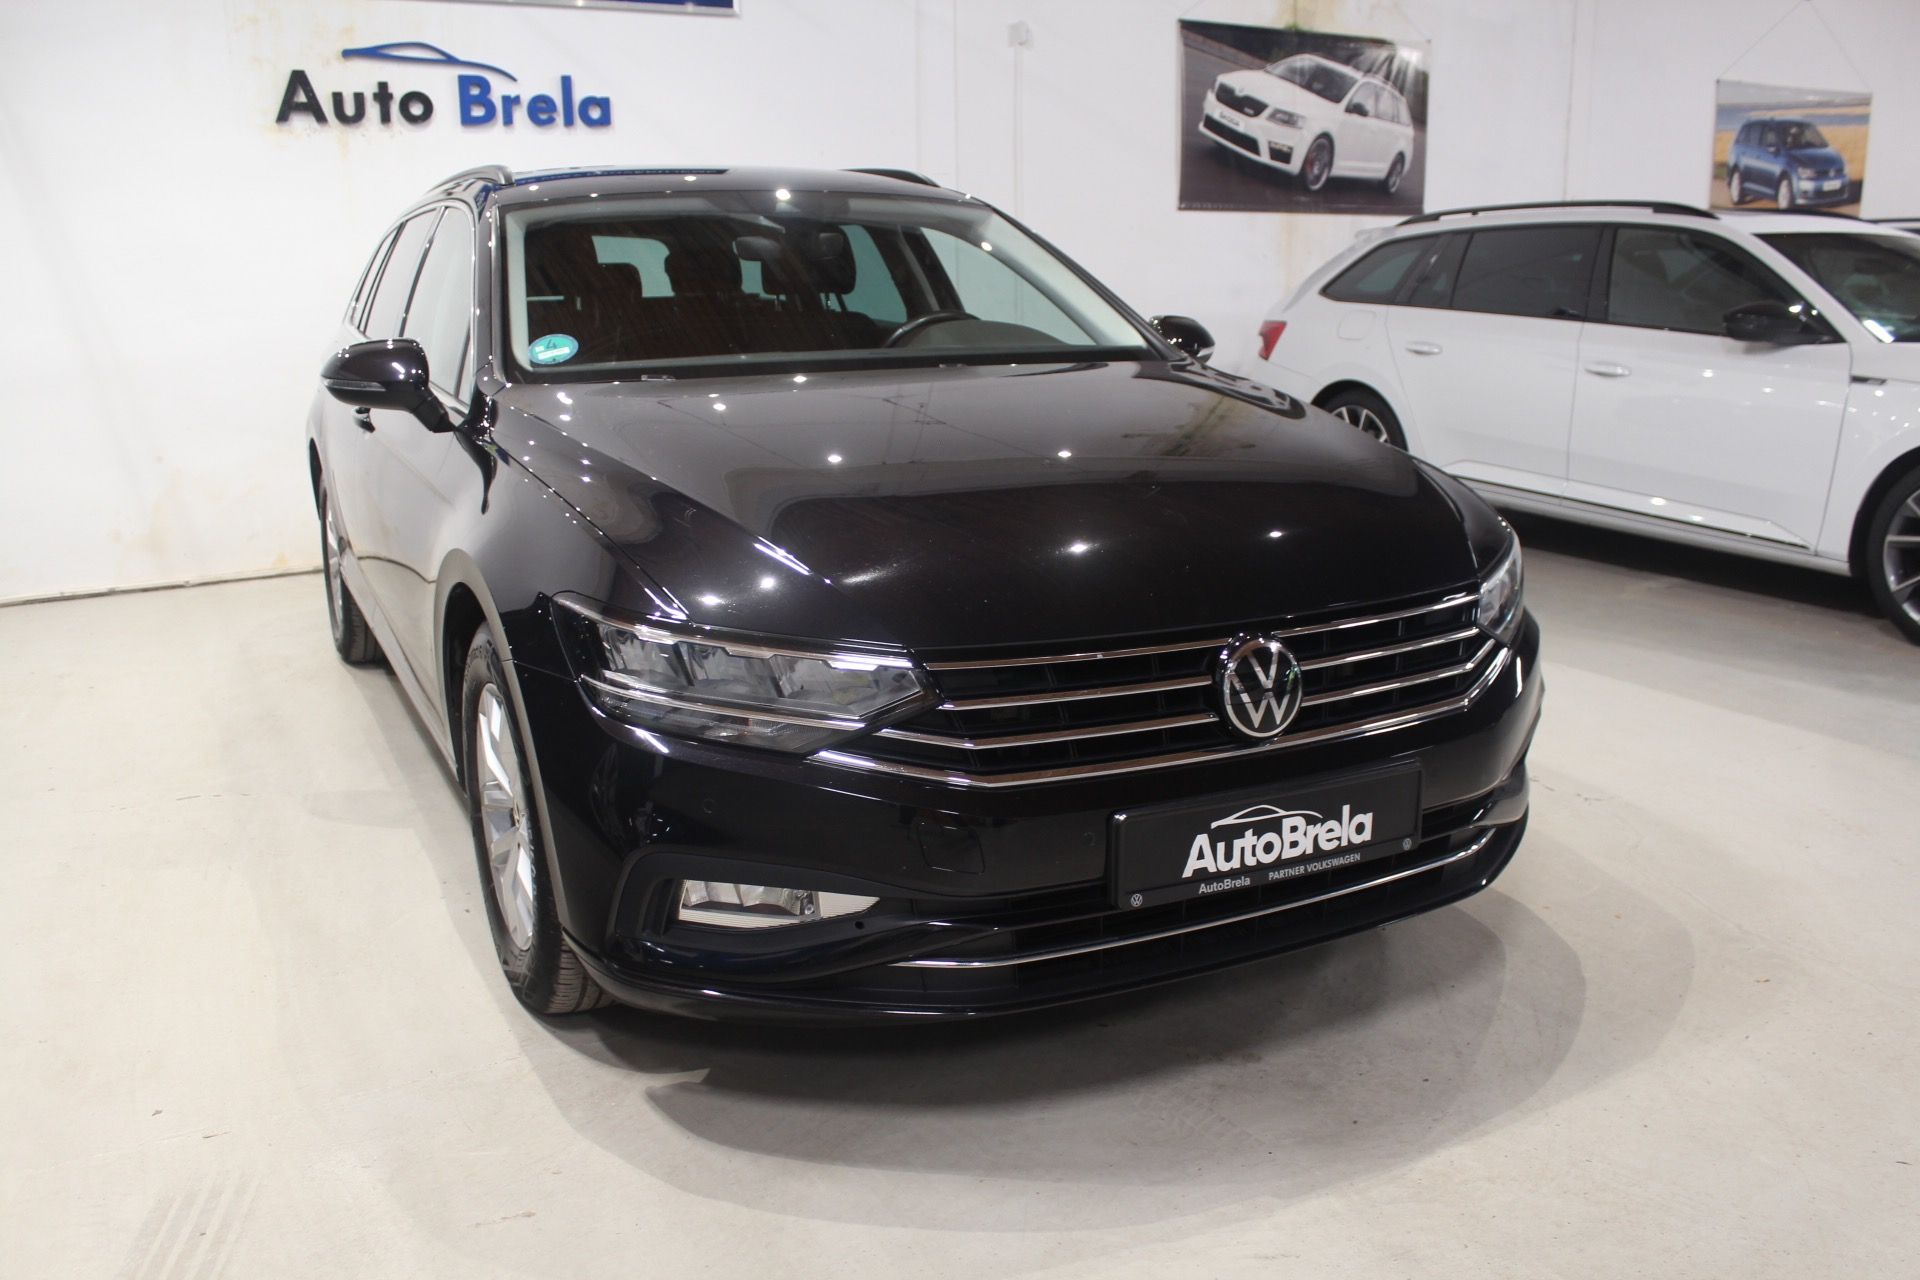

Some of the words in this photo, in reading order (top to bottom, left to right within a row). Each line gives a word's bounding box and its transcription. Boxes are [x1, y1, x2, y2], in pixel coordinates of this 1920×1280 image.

[275, 69, 434, 125] Auto
[457, 74, 612, 128] Brela
[1181, 804, 1374, 879] AutoBrela
[1198, 876, 1251, 895] AutoBrela
[1268, 865, 1305, 881] PARTNER
[1306, 852, 1361, 874] VOLKSWAGEN
